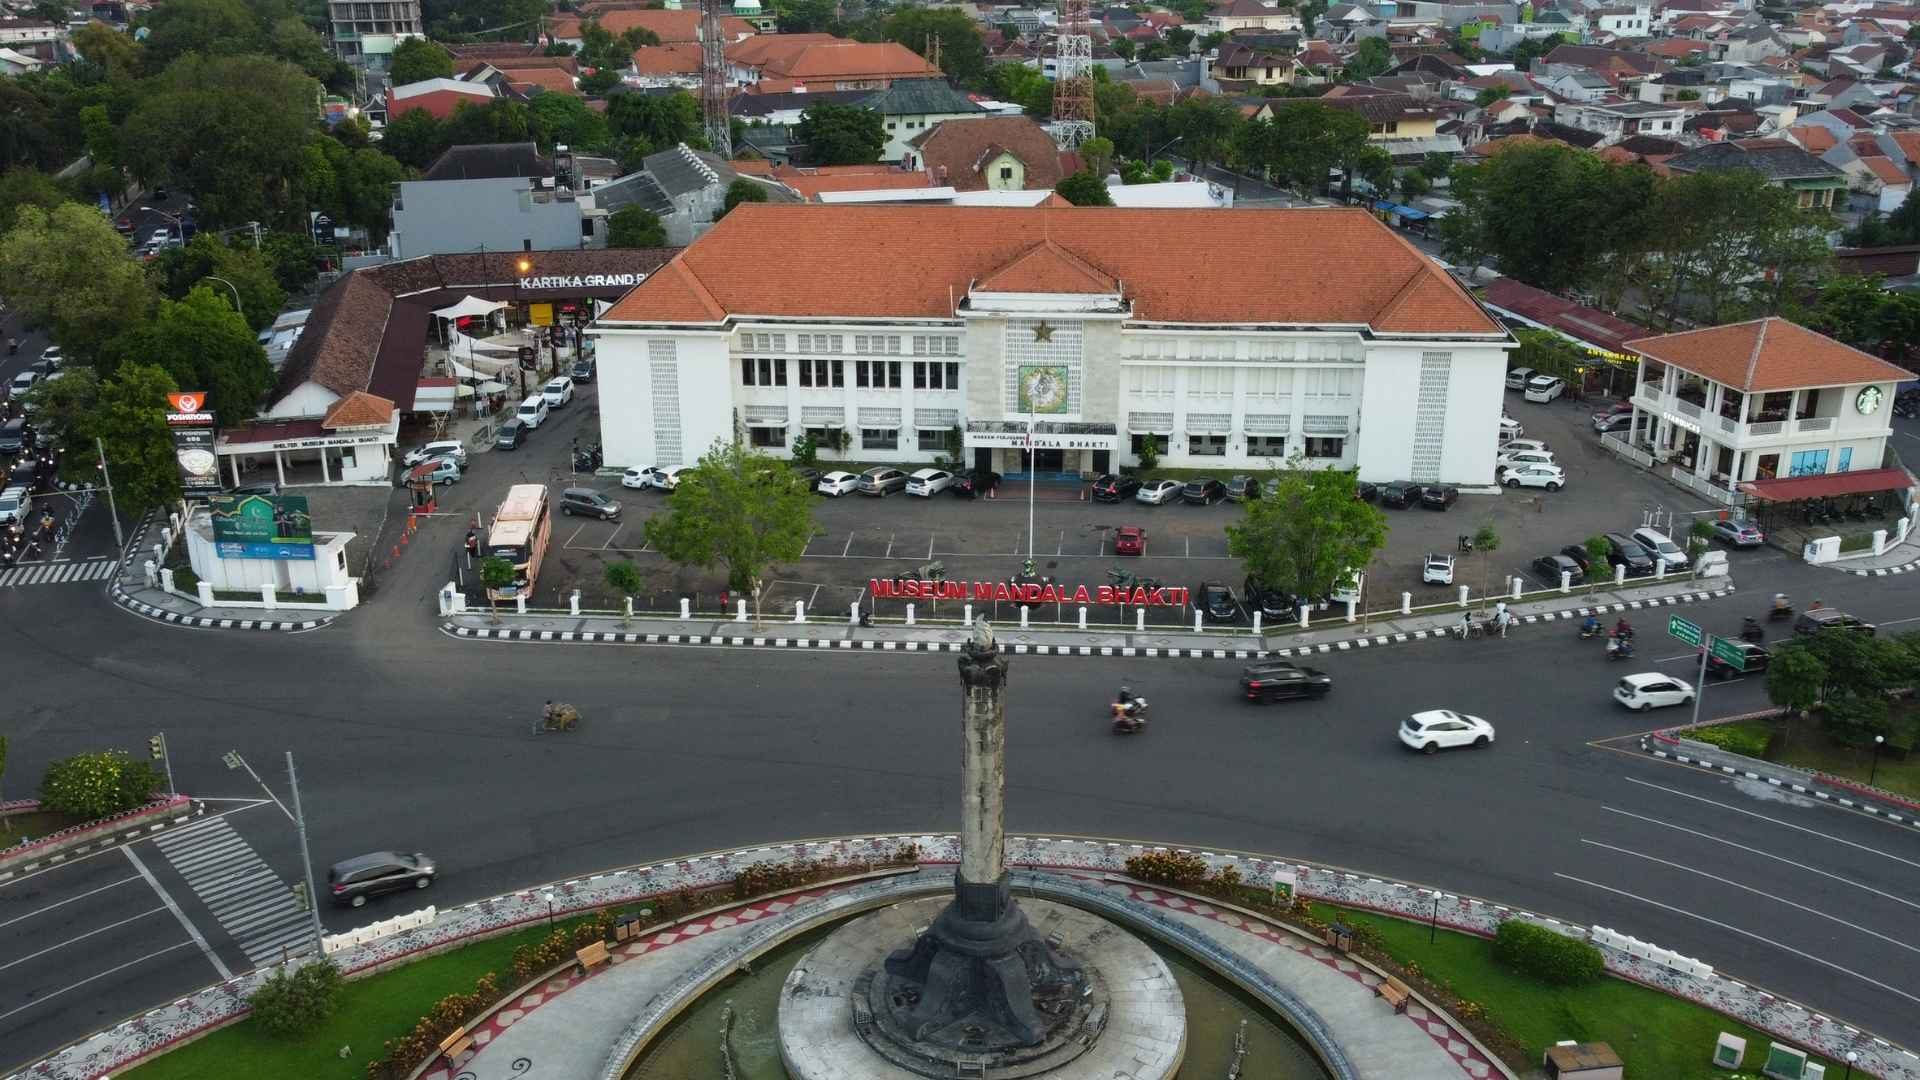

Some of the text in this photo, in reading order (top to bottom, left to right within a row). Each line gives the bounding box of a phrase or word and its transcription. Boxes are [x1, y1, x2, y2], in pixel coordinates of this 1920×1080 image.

[520, 275, 582, 289] KARTIKA
[585, 274, 634, 286] GRAND
[1069, 440, 1109, 449] BHAKTI
[870, 579, 1189, 606] MUSEUM MANDALA BHAKTI
